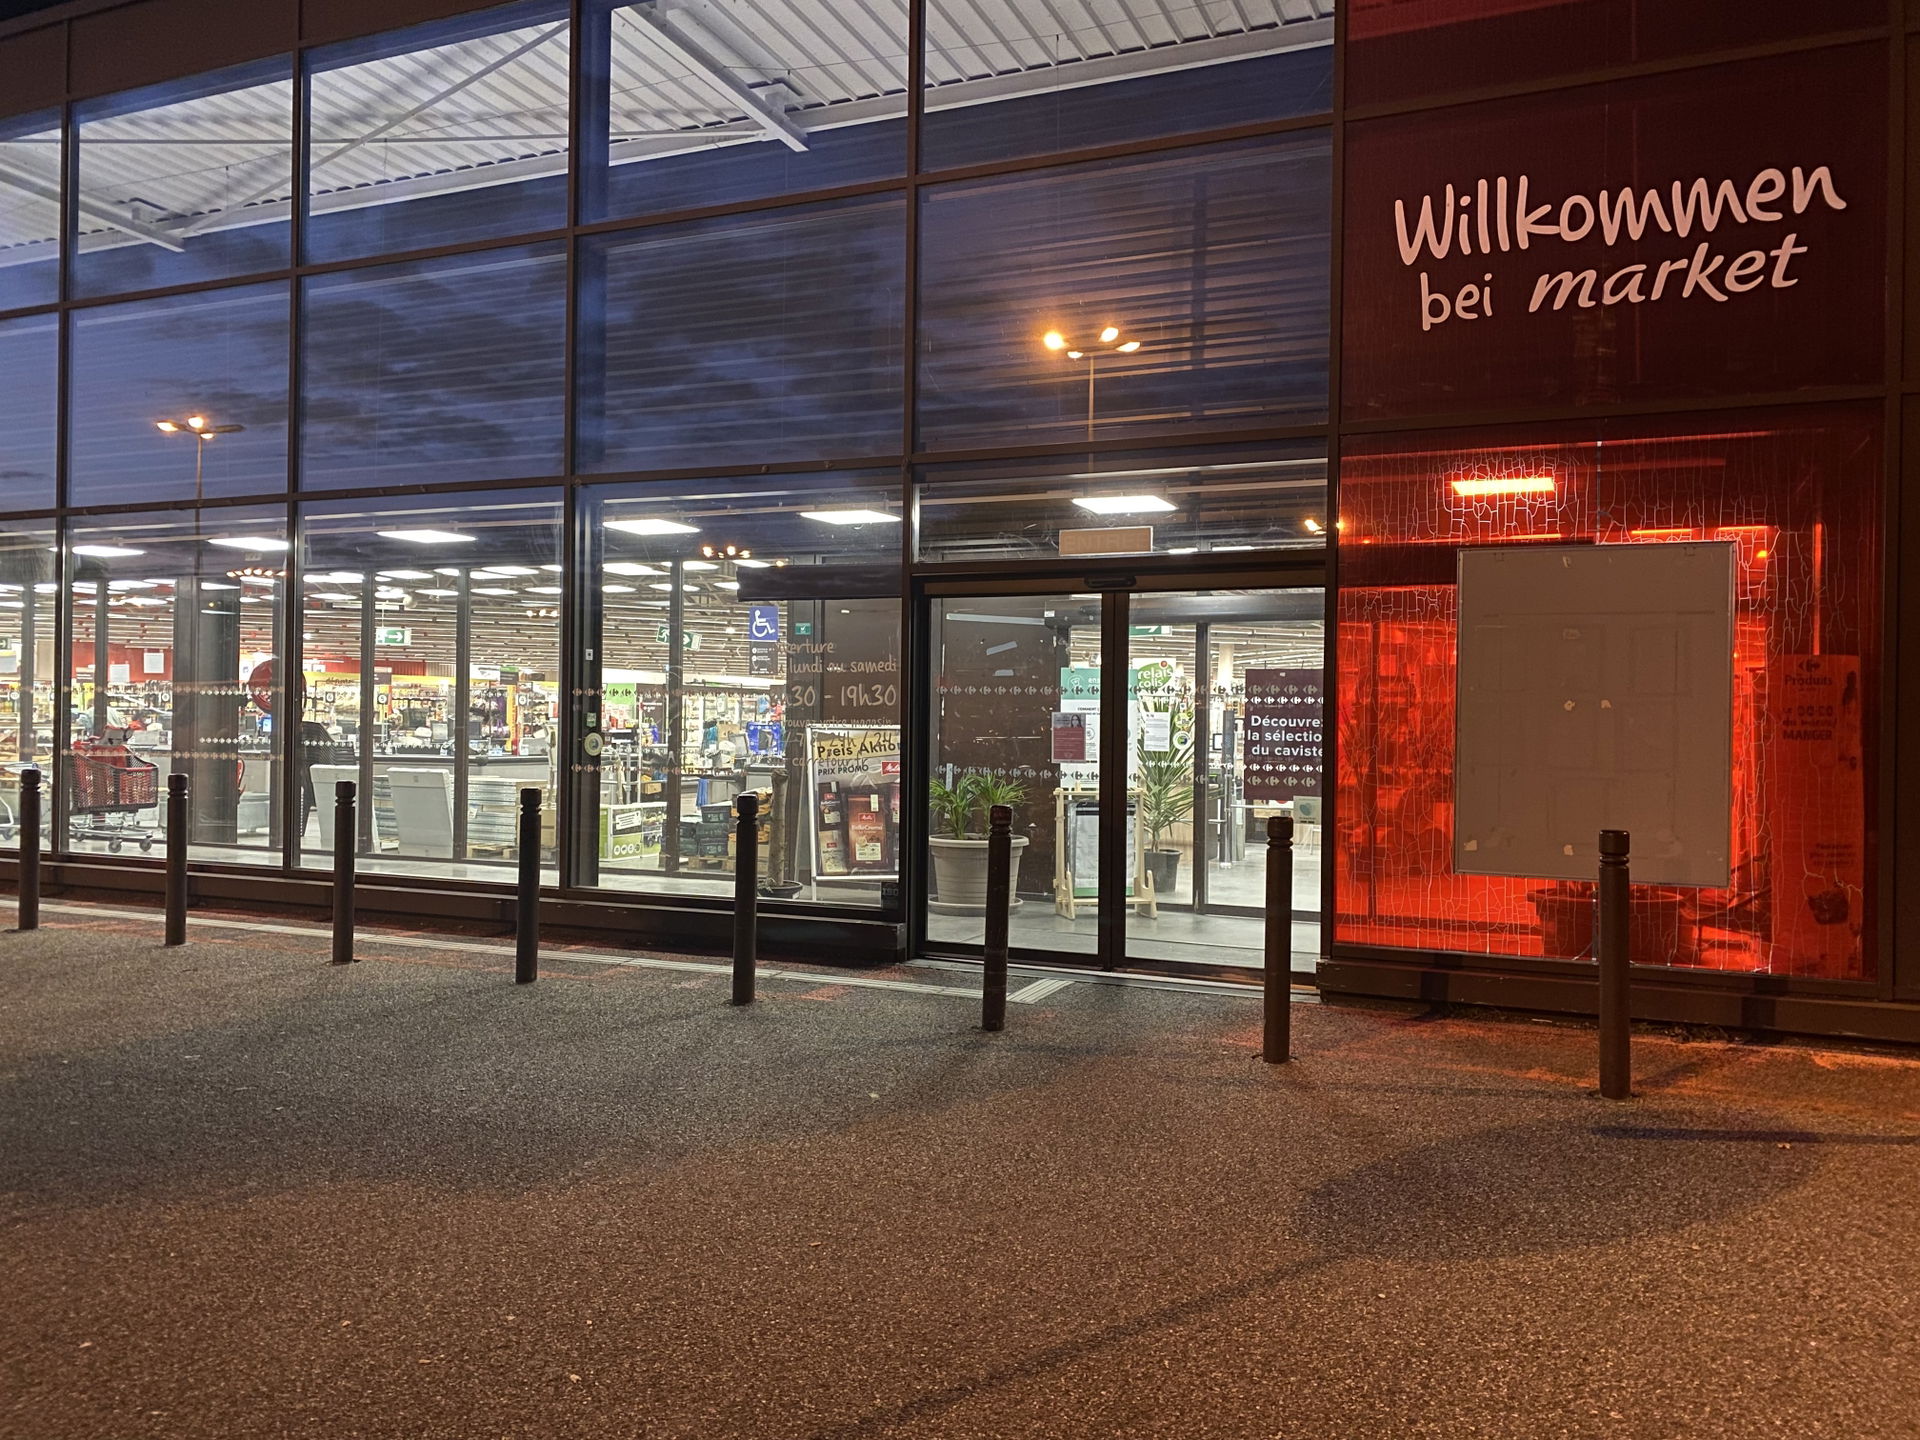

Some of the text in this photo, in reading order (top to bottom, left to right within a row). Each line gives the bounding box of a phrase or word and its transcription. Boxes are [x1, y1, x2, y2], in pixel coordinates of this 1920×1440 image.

[1394, 165, 1847, 266] Willkommen
[1421, 233, 1809, 332] bei market
[789, 655, 823, 674] lundi
[850, 657, 897, 674] samedi
[1137, 667, 1173, 680] relais
[1138, 677, 1164, 690] colis
[841, 683, 898, 708] 19h30
[1247, 729, 1322, 743] la sélectio
[817, 743, 853, 759] Preis
[1251, 744, 1270, 756] du
[817, 764, 869, 777] PRIX PROMO
